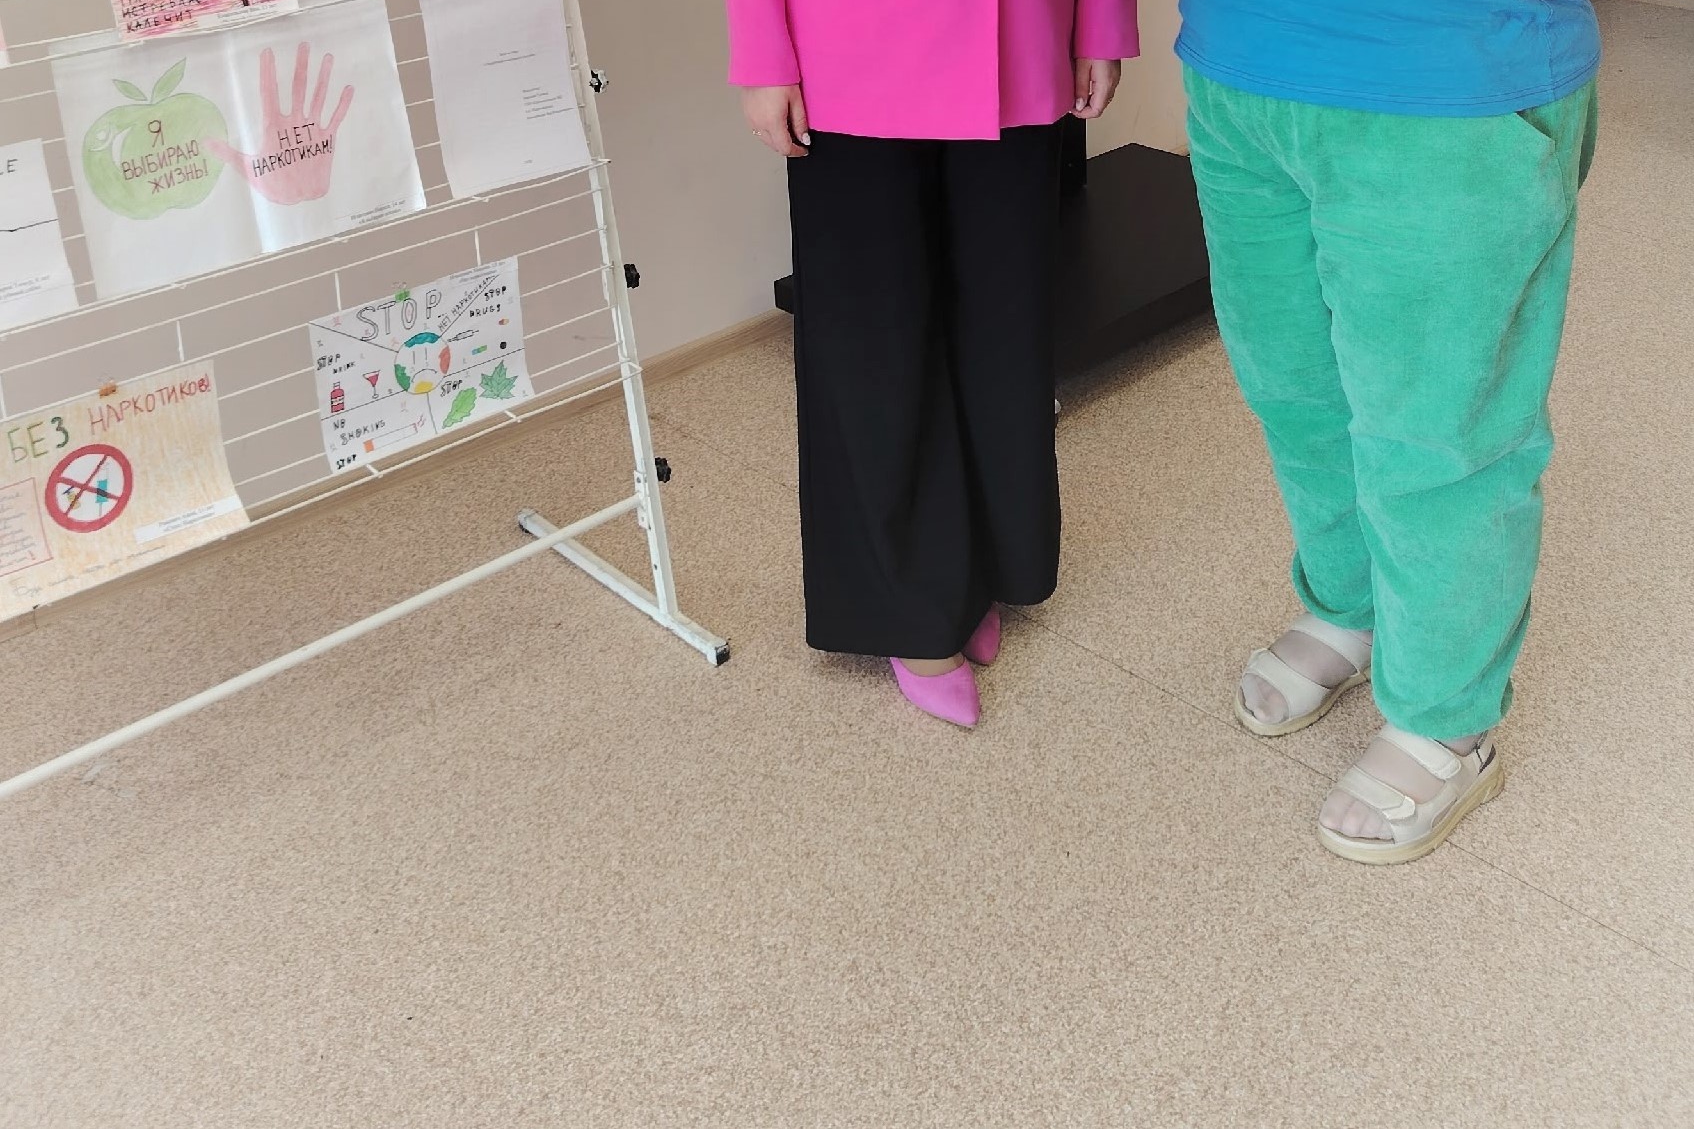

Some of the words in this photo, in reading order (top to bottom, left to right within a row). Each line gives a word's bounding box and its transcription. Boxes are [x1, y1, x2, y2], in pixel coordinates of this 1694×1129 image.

[126, 10, 194, 33] КАЛЕЧИТ
[147, 119, 166, 149] Я
[277, 122, 315, 150] НЕТ
[121, 139, 200, 182] ВЫБИРАЮ
[251, 134, 334, 178] НАРКОТИКАМ!
[147, 158, 209, 195] ЖИЗНЬ!
[356, 289, 442, 342] STOP
[7, 416, 70, 464] БЕЗ
[88, 372, 211, 436] НАРКОТИКОВ!
